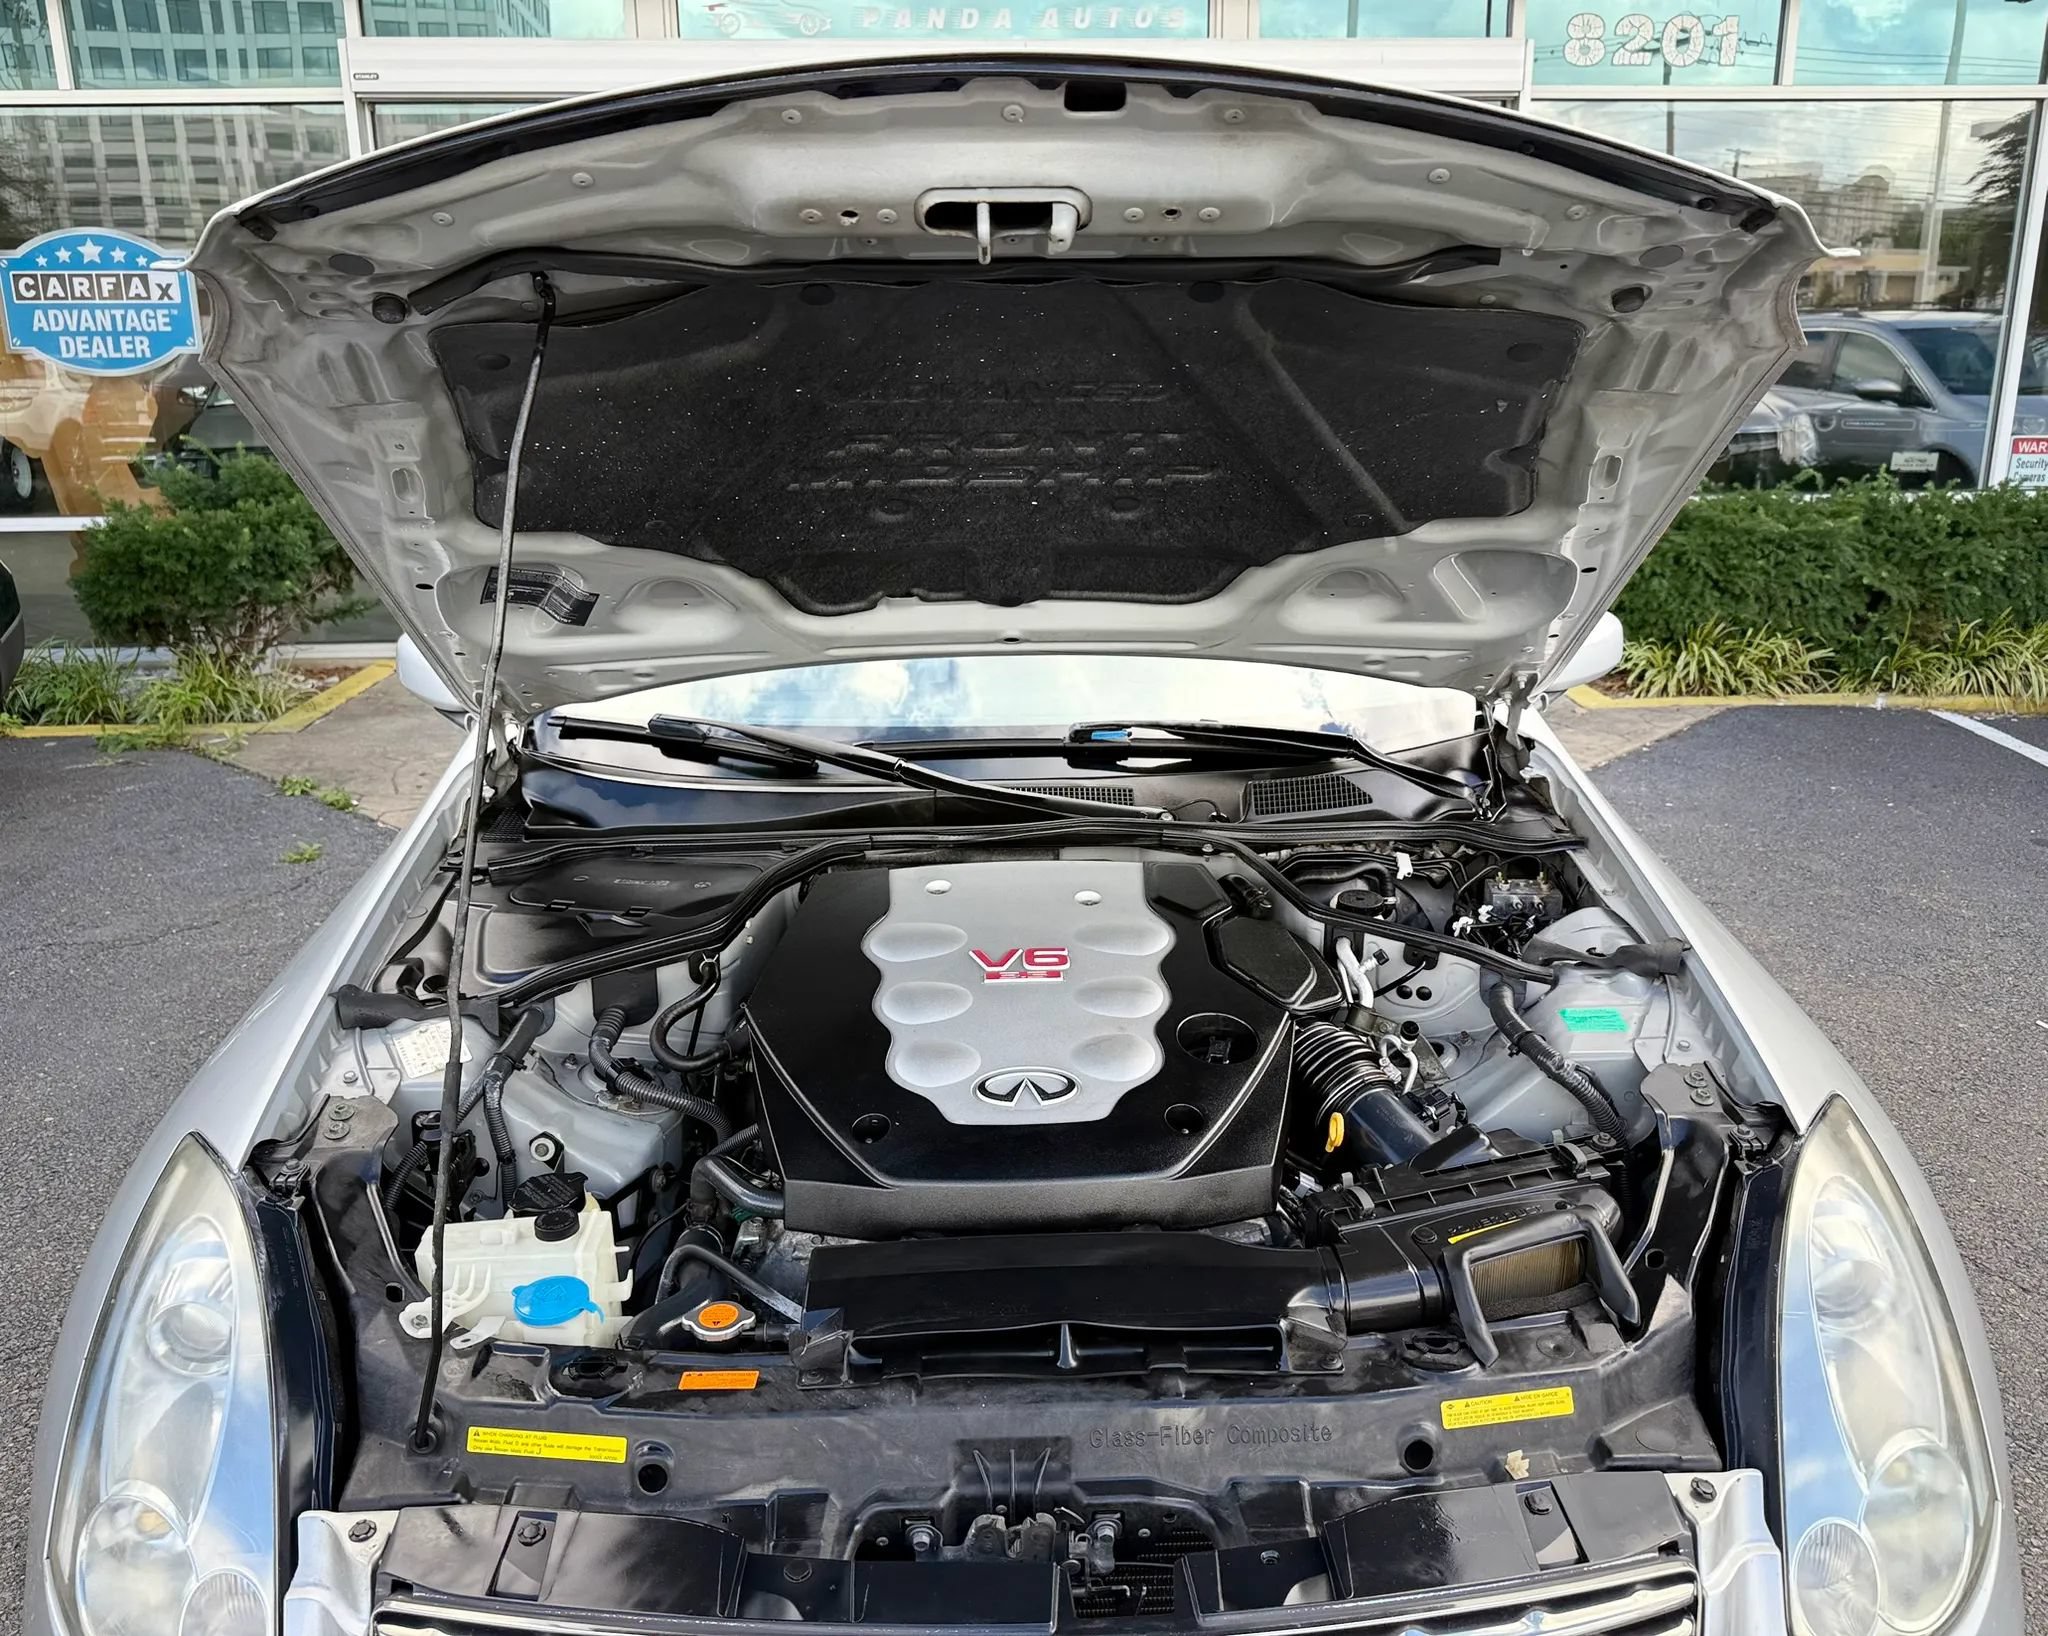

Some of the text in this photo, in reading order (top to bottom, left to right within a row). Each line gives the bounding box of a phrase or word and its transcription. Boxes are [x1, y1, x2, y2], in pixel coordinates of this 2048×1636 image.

[860, 6, 1186, 30] PANDA AUTOS
[1563, 13, 1740, 67] 8201
[16, 275, 176, 302] CARFAX
[33, 309, 172, 332] ADVANTAGE
[59, 336, 151, 358] DEALER
[2016, 457, 2048, 471] Security
[968, 947, 1071, 972] V6
[1089, 1423, 1333, 1448] Glass-Fiber Composite
